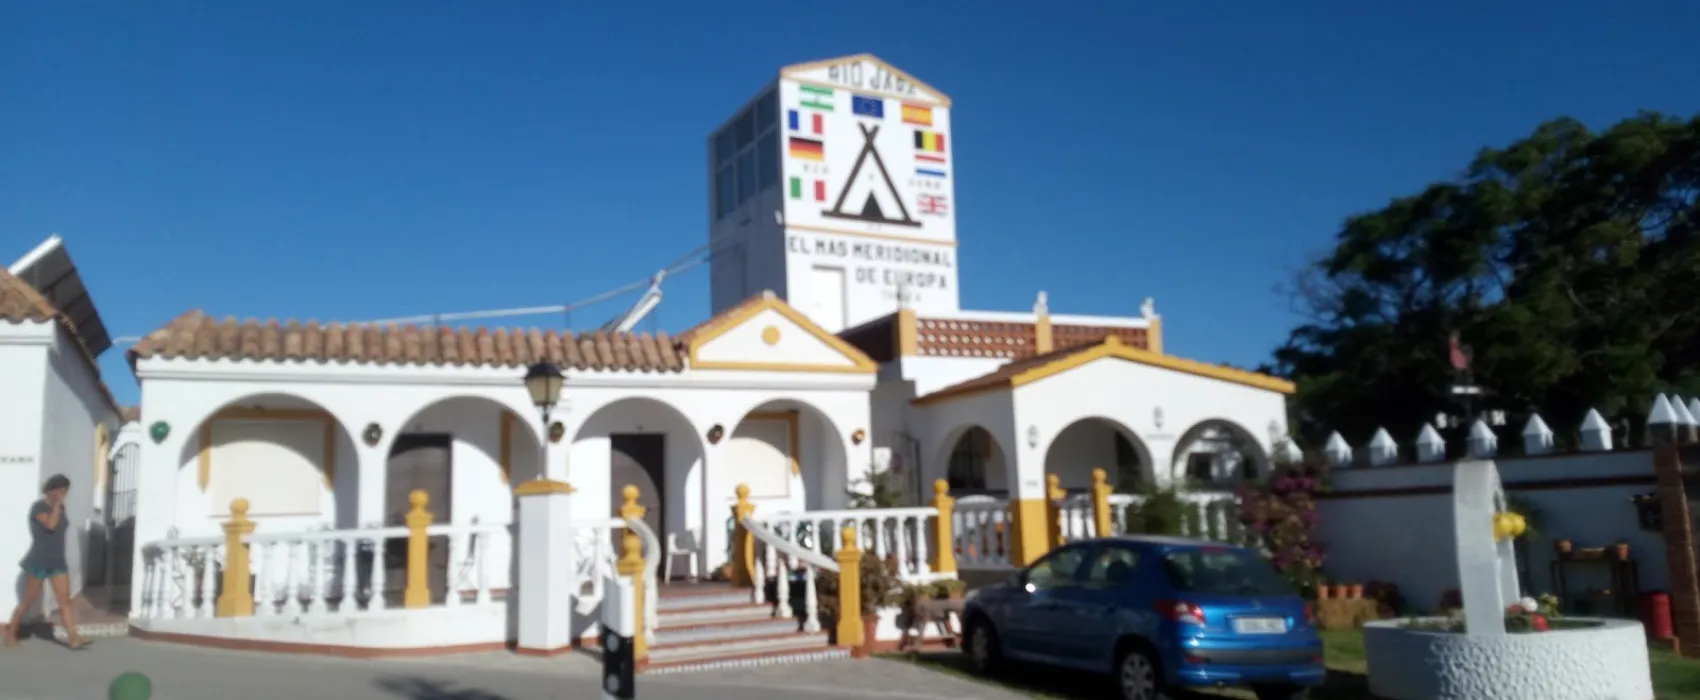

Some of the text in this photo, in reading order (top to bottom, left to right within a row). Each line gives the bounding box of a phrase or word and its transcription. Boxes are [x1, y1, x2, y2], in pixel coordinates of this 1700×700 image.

[827, 61, 863, 88] RIO
[788, 235, 953, 269] EL MAS MERIDIONAL
[855, 267, 948, 290] DE EUROPA
